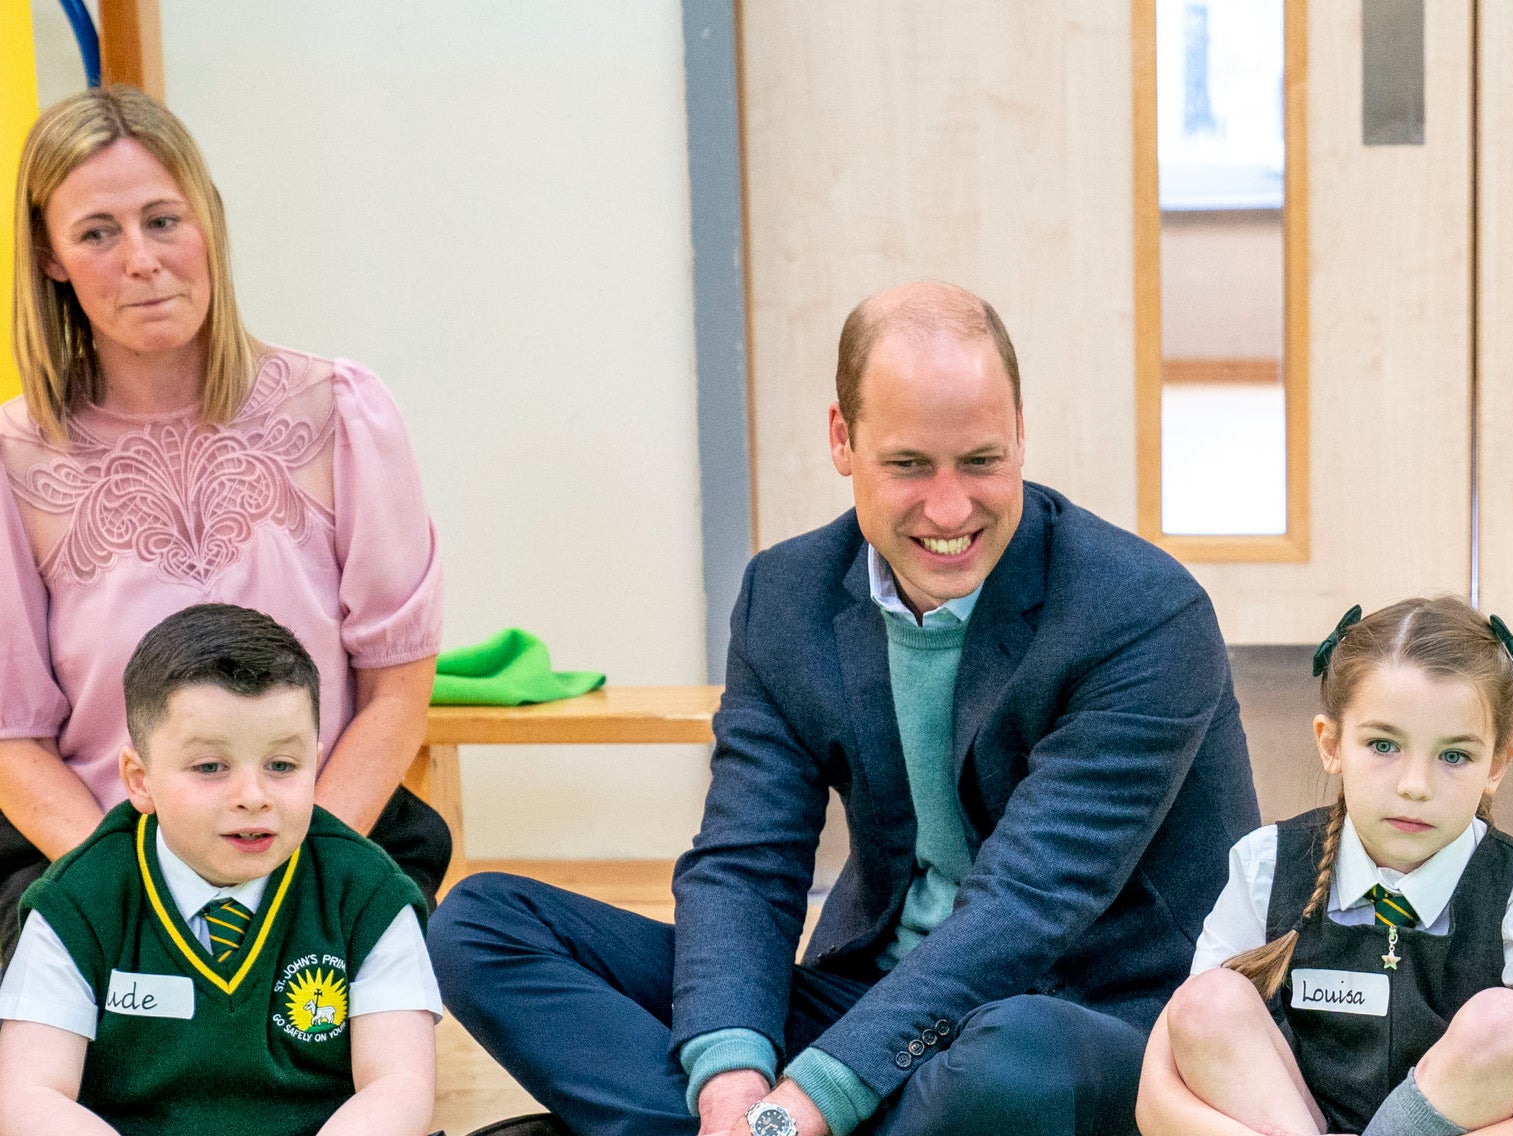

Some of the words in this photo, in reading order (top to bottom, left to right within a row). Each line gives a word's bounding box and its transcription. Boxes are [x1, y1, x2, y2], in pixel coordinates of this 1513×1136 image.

[283, 953, 318, 979] JOHN'S
[1302, 980, 1366, 1005] Louisa
[272, 1013, 285, 1027] GO
[283, 1024, 313, 1042] SAFELY
[314, 1033, 327, 1042] ON
